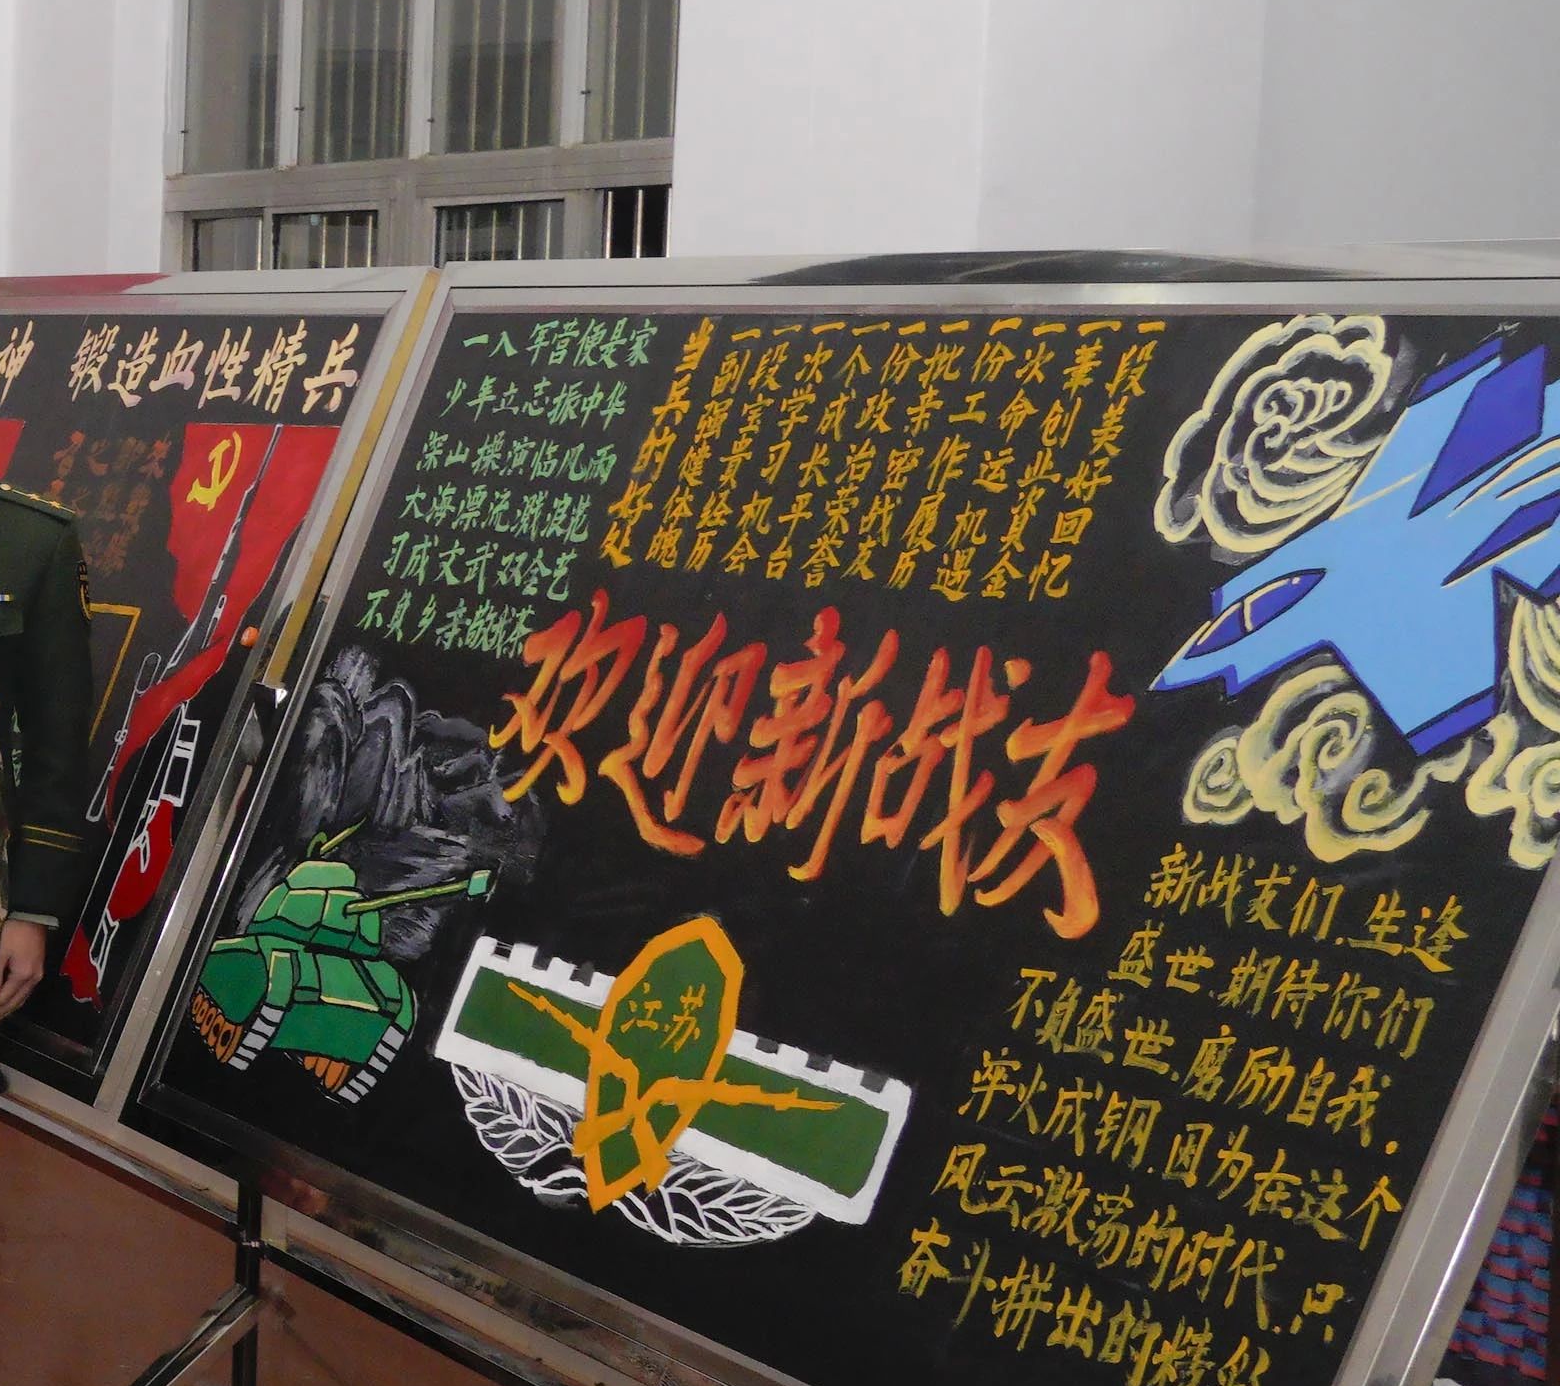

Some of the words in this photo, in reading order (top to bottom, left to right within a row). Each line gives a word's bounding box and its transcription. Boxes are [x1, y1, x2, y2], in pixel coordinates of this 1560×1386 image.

[416, 430, 618, 485] 深山操演临风雨
[440, 375, 628, 431] 少年立志振中华
[464, 317, 657, 369] 一入军营便是家
[599, 317, 714, 569] 当兵的好处
[645, 328, 762, 569] 一副强健体魄
[720, 322, 846, 575] 一次学习机会
[766, 320, 890, 581] 一个成长平台
[801, 321, 927, 589] 一份政治荣誉
[840, 321, 970, 581] 一批亲密战友
[887, 317, 1023, 590] 一份工作履历
[930, 323, 1068, 603] 一次命运机遇
[1028, 321, 1166, 602] 一段美好回忆
[384, 531, 578, 601] 习成文武双全艺
[489, 588, 1135, 940] 欢迎新战友
[621, 982, 706, 1053] 江苏
